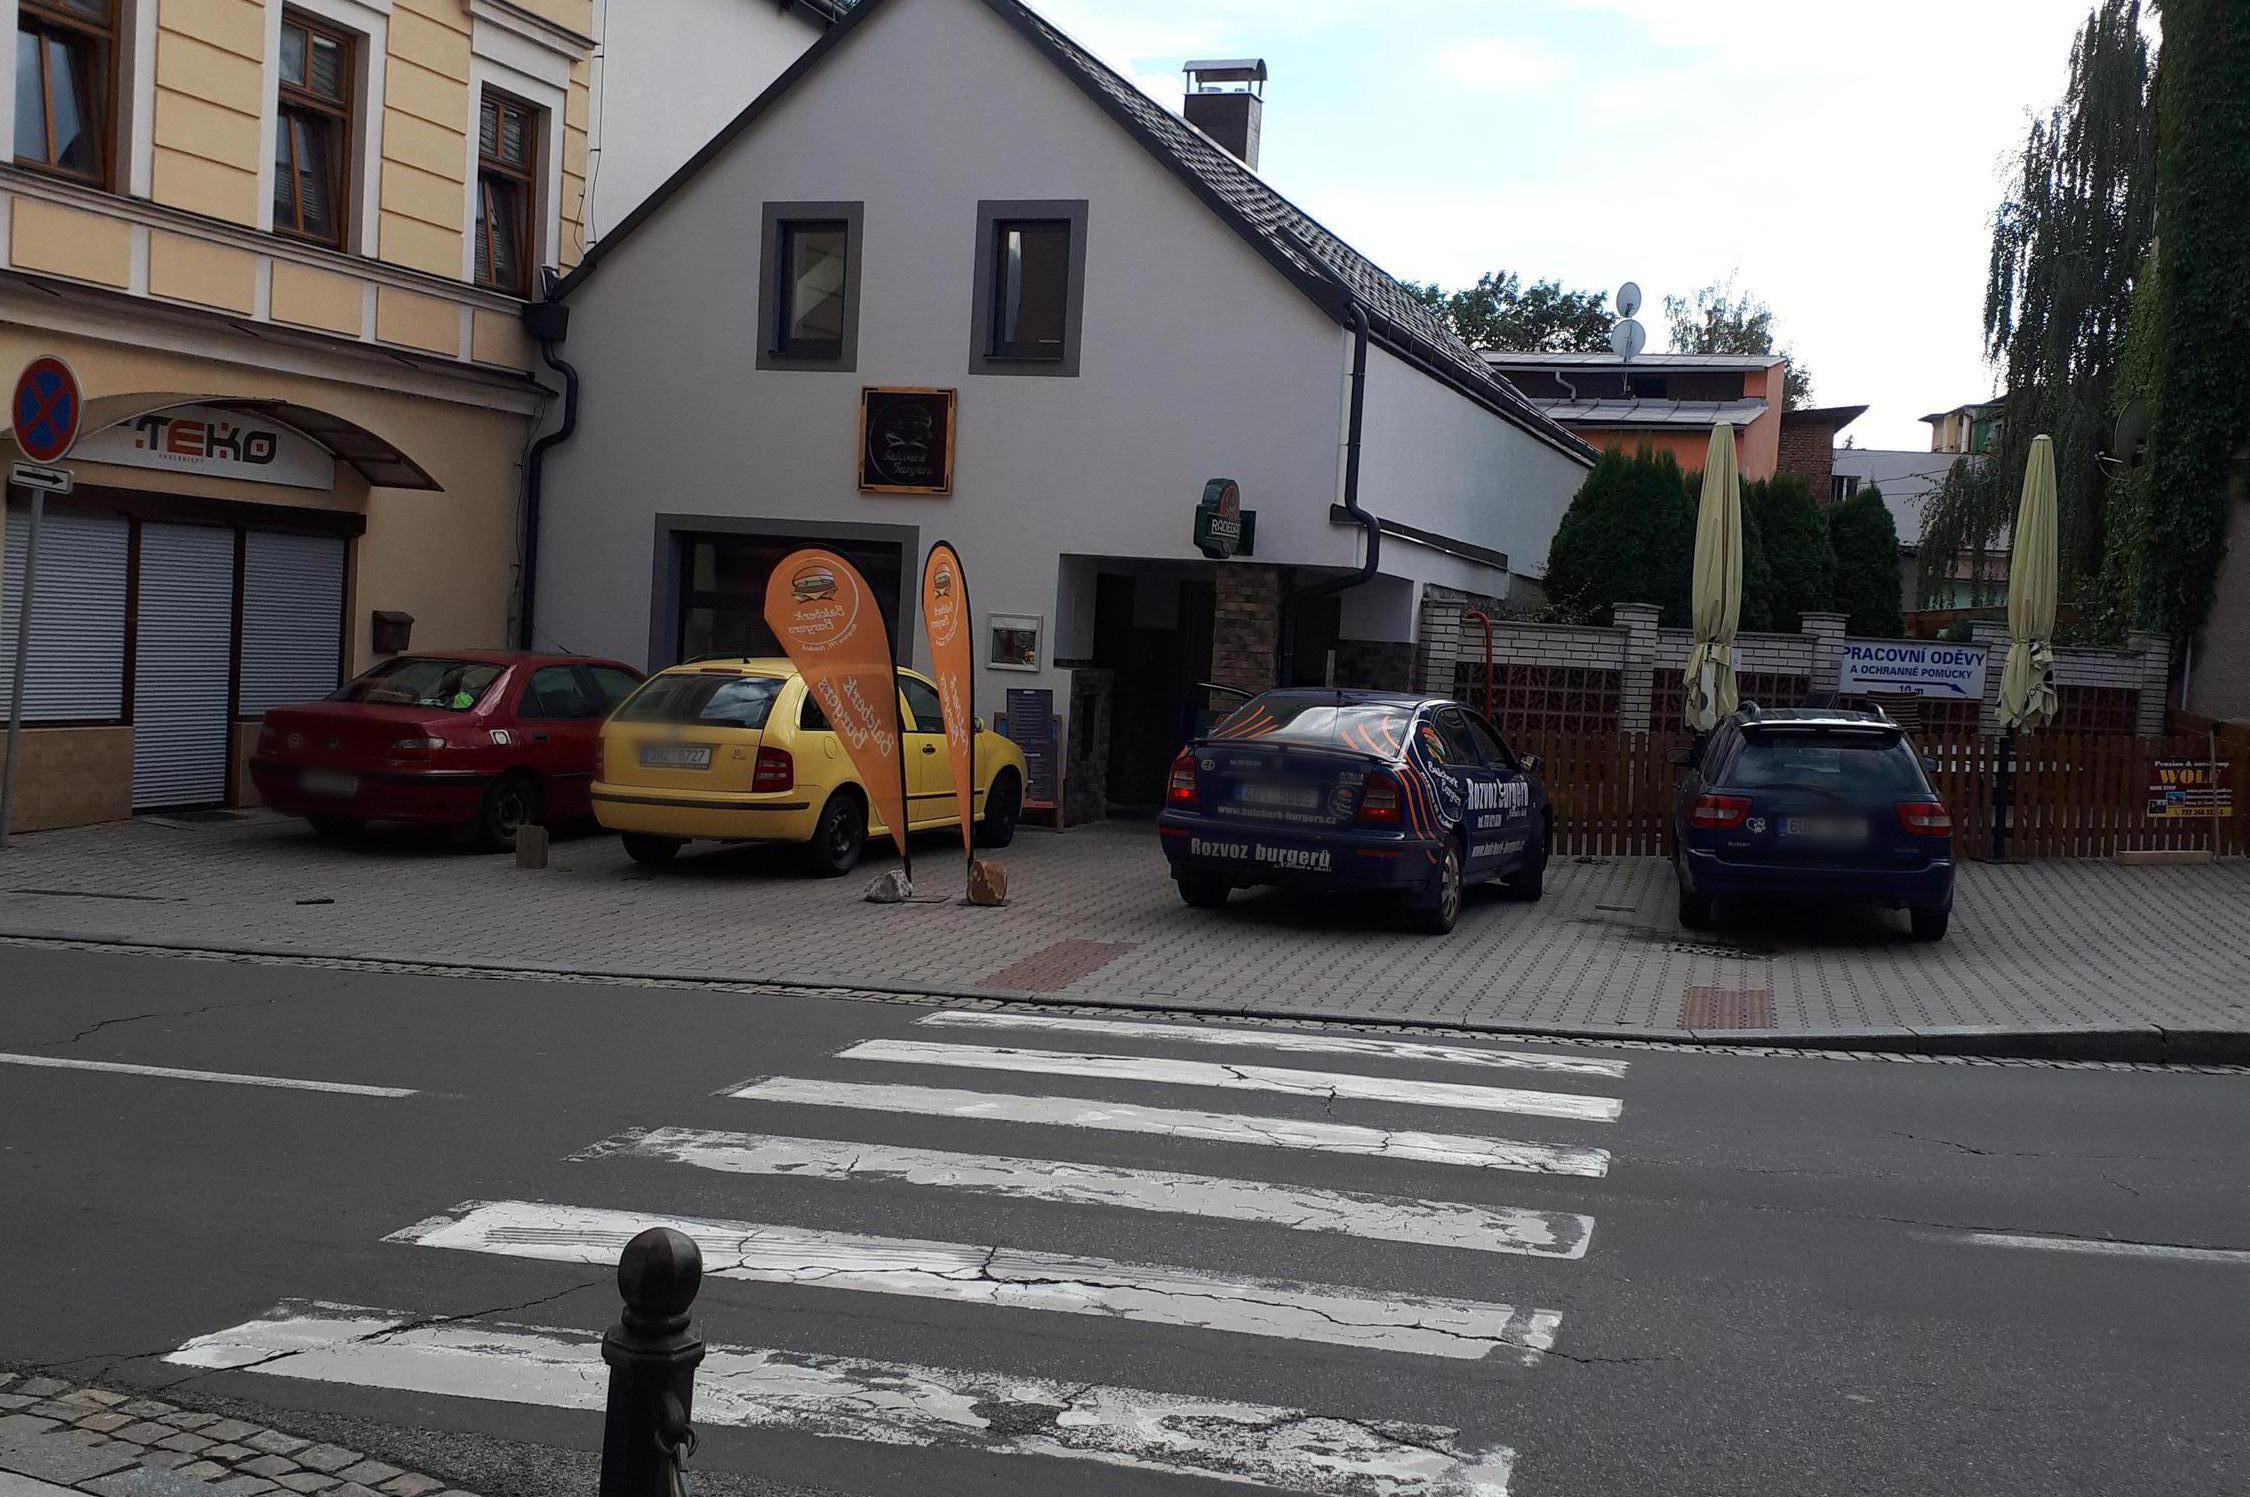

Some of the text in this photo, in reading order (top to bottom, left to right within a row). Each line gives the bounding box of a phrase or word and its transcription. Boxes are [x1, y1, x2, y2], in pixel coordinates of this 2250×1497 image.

[136, 415, 277, 465] TEKO
[1844, 646, 1985, 667] PRACOVNÍ ODĚVY
[1850, 665, 1858, 674] A
[1861, 666, 1919, 677] OCHRANNÉ
[1466, 778, 1498, 810] Rozvoz
[1191, 838, 1248, 860] Rozvoz
[1255, 844, 1332, 868] burgerů
